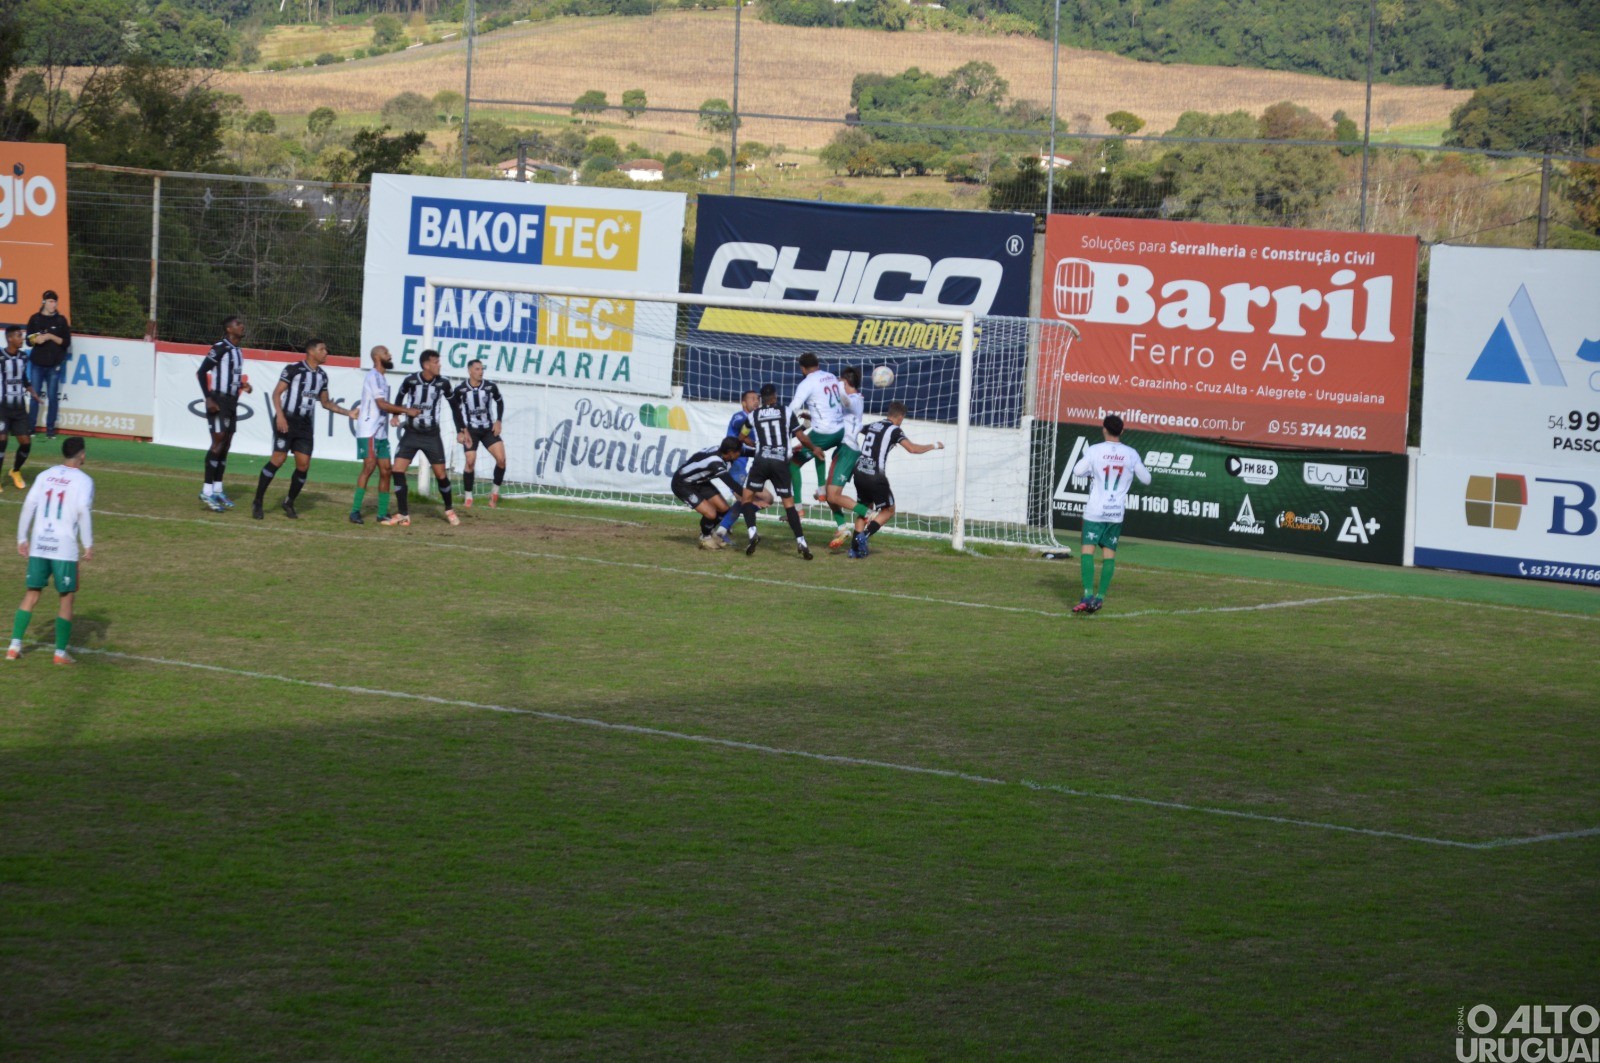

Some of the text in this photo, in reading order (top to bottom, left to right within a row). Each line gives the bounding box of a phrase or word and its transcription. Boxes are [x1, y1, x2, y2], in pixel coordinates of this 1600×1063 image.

[419, 206, 620, 261] BAKOF TEC
[1081, 235, 1375, 266] Soluções para Serralheria e Construção Civil
[702, 241, 1003, 322] CHICO
[1085, 261, 1395, 343] Barril
[547, 295, 615, 341] TEC
[855, 318, 982, 352] AUTOMOVES
[401, 338, 631, 383] EGENHARIA
[1130, 333, 1326, 382] Ferro e Aço
[1053, 370, 1106, 385] Frederico
[1108, 374, 1122, 386] W.
[1130, 376, 1187, 391] Carazinho
[1195, 381, 1221, 394] Cruz
[1223, 383, 1247, 395] Alta
[1256, 385, 1306, 400] Alegrete
[1316, 389, 1385, 404] Uruguaiana
[574, 397, 636, 431] Posto
[760, 419, 783, 446] 11
[862, 432, 876, 457] 2
[1282, 421, 1298, 436] 55
[1300, 422, 1331, 438] 3744
[1334, 425, 1367, 440] 2062
[534, 419, 689, 479] Avenida
[1144, 450, 1194, 470] 89.9
[1102, 464, 1124, 491] 17
[1153, 467, 1194, 477] FORTALEZA
[1244, 463, 1274, 475] FM 88.5
[1348, 468, 1366, 480] TV
[44, 488, 66, 520] 11
[1053, 500, 1067, 510] LUZ
[1067, 503, 1073, 511] E
[1141, 495, 1168, 513] 1160
[1173, 498, 1199, 517] 95.9
[1202, 501, 1220, 519] FM
[1229, 521, 1265, 535] Avenida
[1530, 565, 1600, 581] 55 3744 4166
